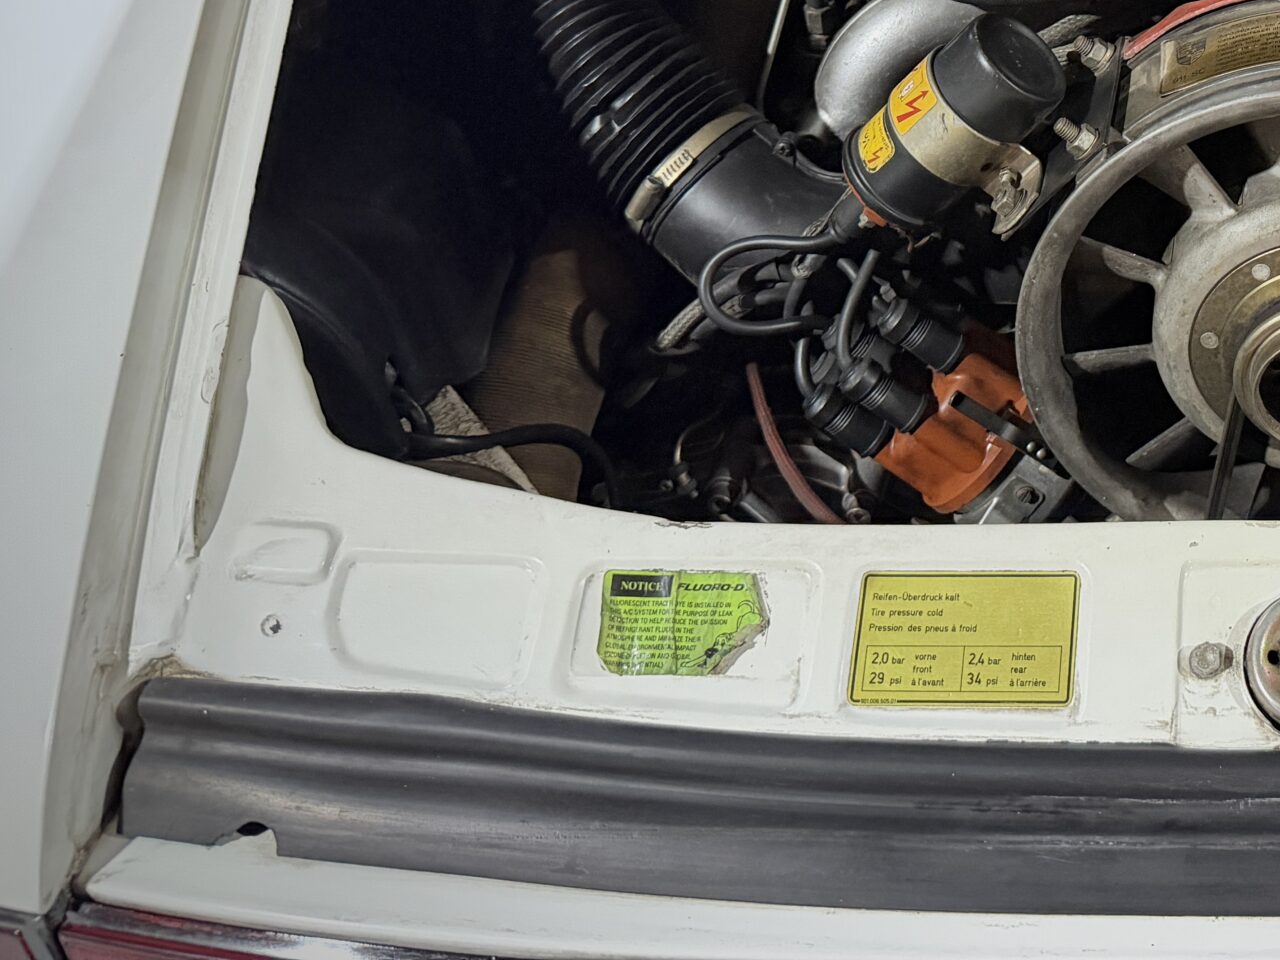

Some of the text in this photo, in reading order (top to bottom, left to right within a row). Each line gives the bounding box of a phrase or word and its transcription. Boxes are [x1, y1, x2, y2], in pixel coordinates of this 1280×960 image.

[621, 580, 664, 591] NOTICE
[873, 592, 960, 601] Reifen-Überdruck kalt
[872, 608, 943, 618] Tire pressure cold
[869, 624, 978, 634] Pression des pneus à froid
[872, 652, 905, 666] 2,0 bar
[968, 652, 1001, 666] 2,4 bar
[1012, 652, 1036, 661] hinten
[912, 665, 932, 673] front
[869, 672, 902, 686] 29 psi
[918, 678, 944, 686] l'avant
[967, 672, 998, 687] 34 psi
[1016, 678, 1046, 687] l'arrière
